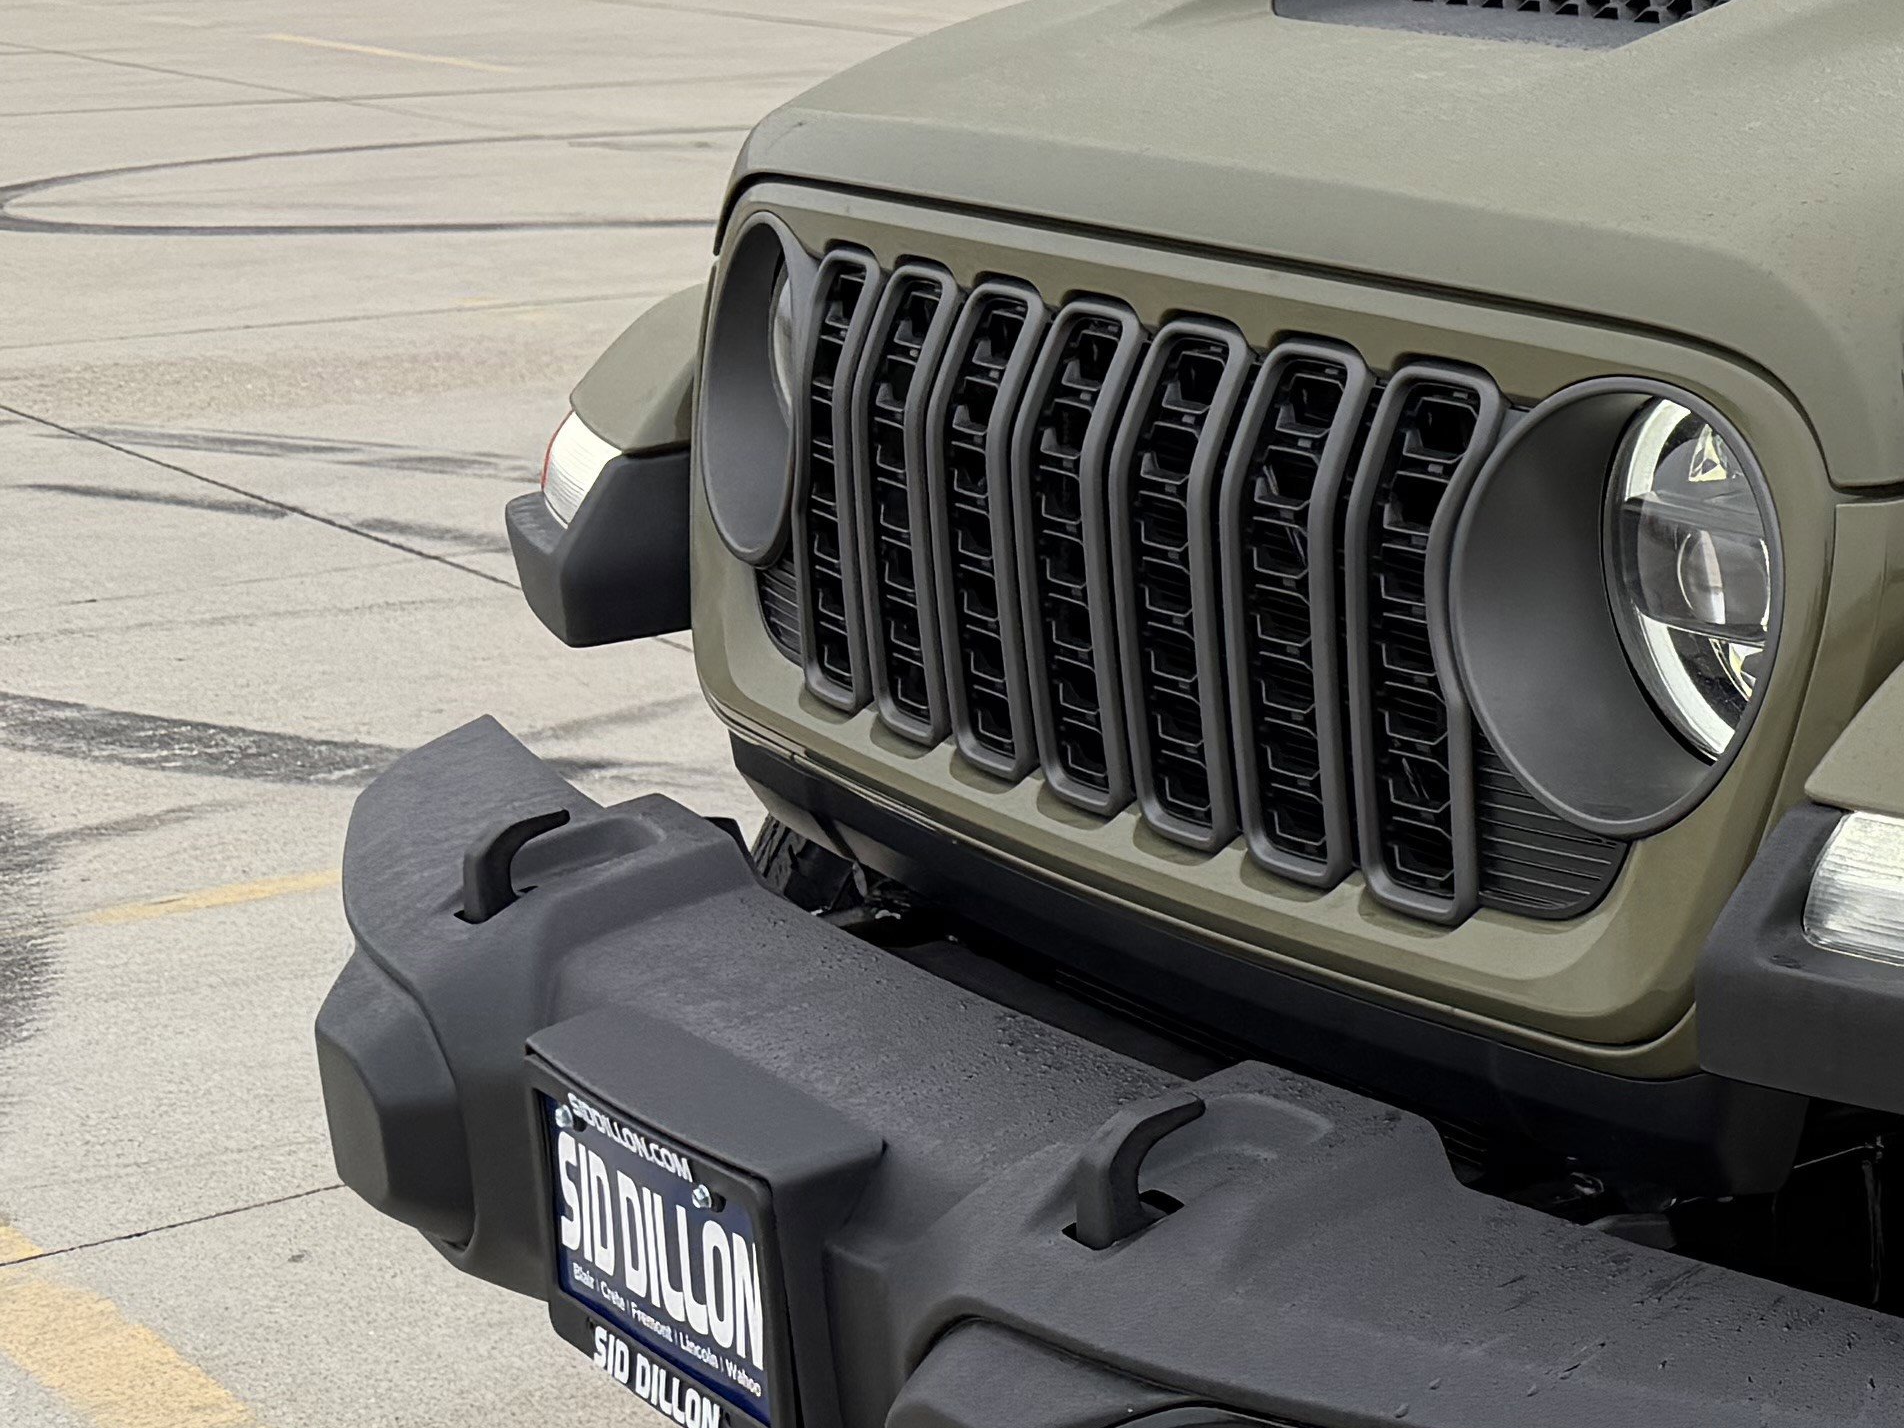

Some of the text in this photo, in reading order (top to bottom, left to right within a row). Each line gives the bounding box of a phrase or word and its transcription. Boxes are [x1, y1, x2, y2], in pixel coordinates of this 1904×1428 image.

[567, 1092, 693, 1183] SIDDILLON.COM
[557, 1130, 765, 1371] SID DILLON
[572, 1262, 595, 1290] Blair
[631, 1301, 674, 1343] Fremont
[679, 1331, 719, 1370] Lincoln
[725, 1358, 763, 1398] Wahoo
[593, 1325, 630, 1385] SID
